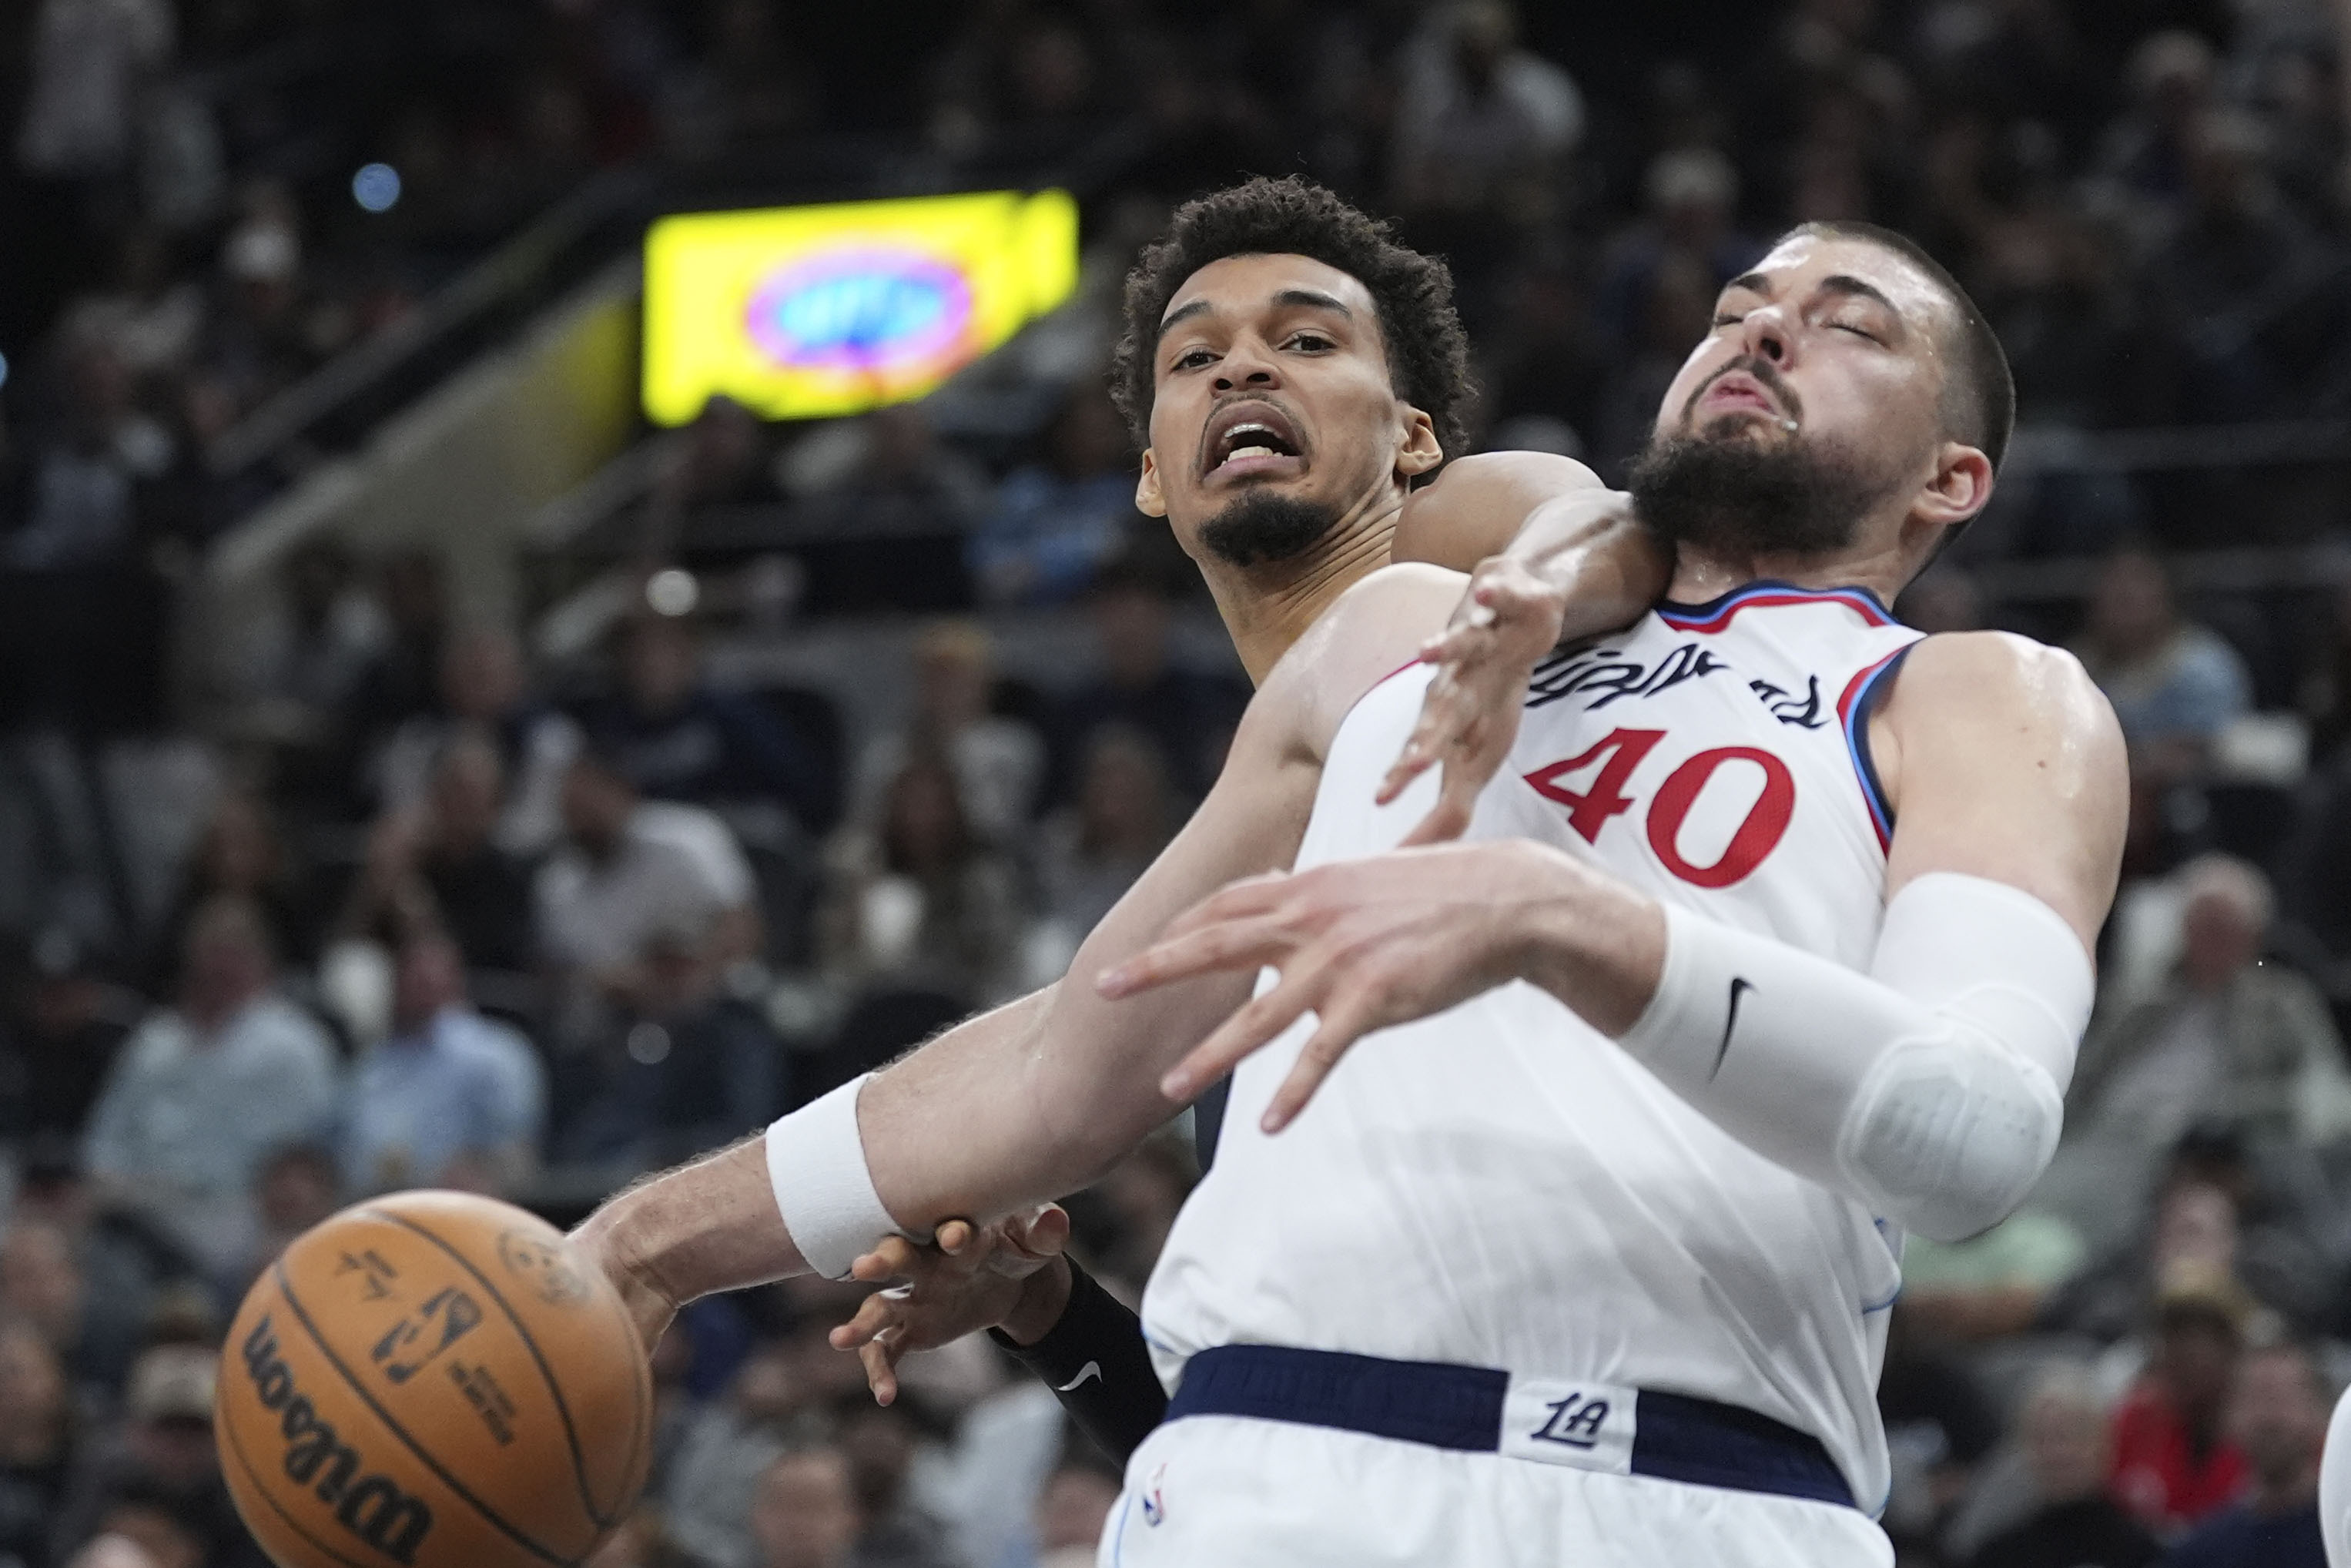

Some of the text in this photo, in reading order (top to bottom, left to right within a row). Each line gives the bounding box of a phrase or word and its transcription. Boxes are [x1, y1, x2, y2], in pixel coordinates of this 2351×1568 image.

[1522, 726, 1796, 890] 40
[242, 1311, 434, 1566] Wilson
[1530, 1392, 1609, 1450] LA
